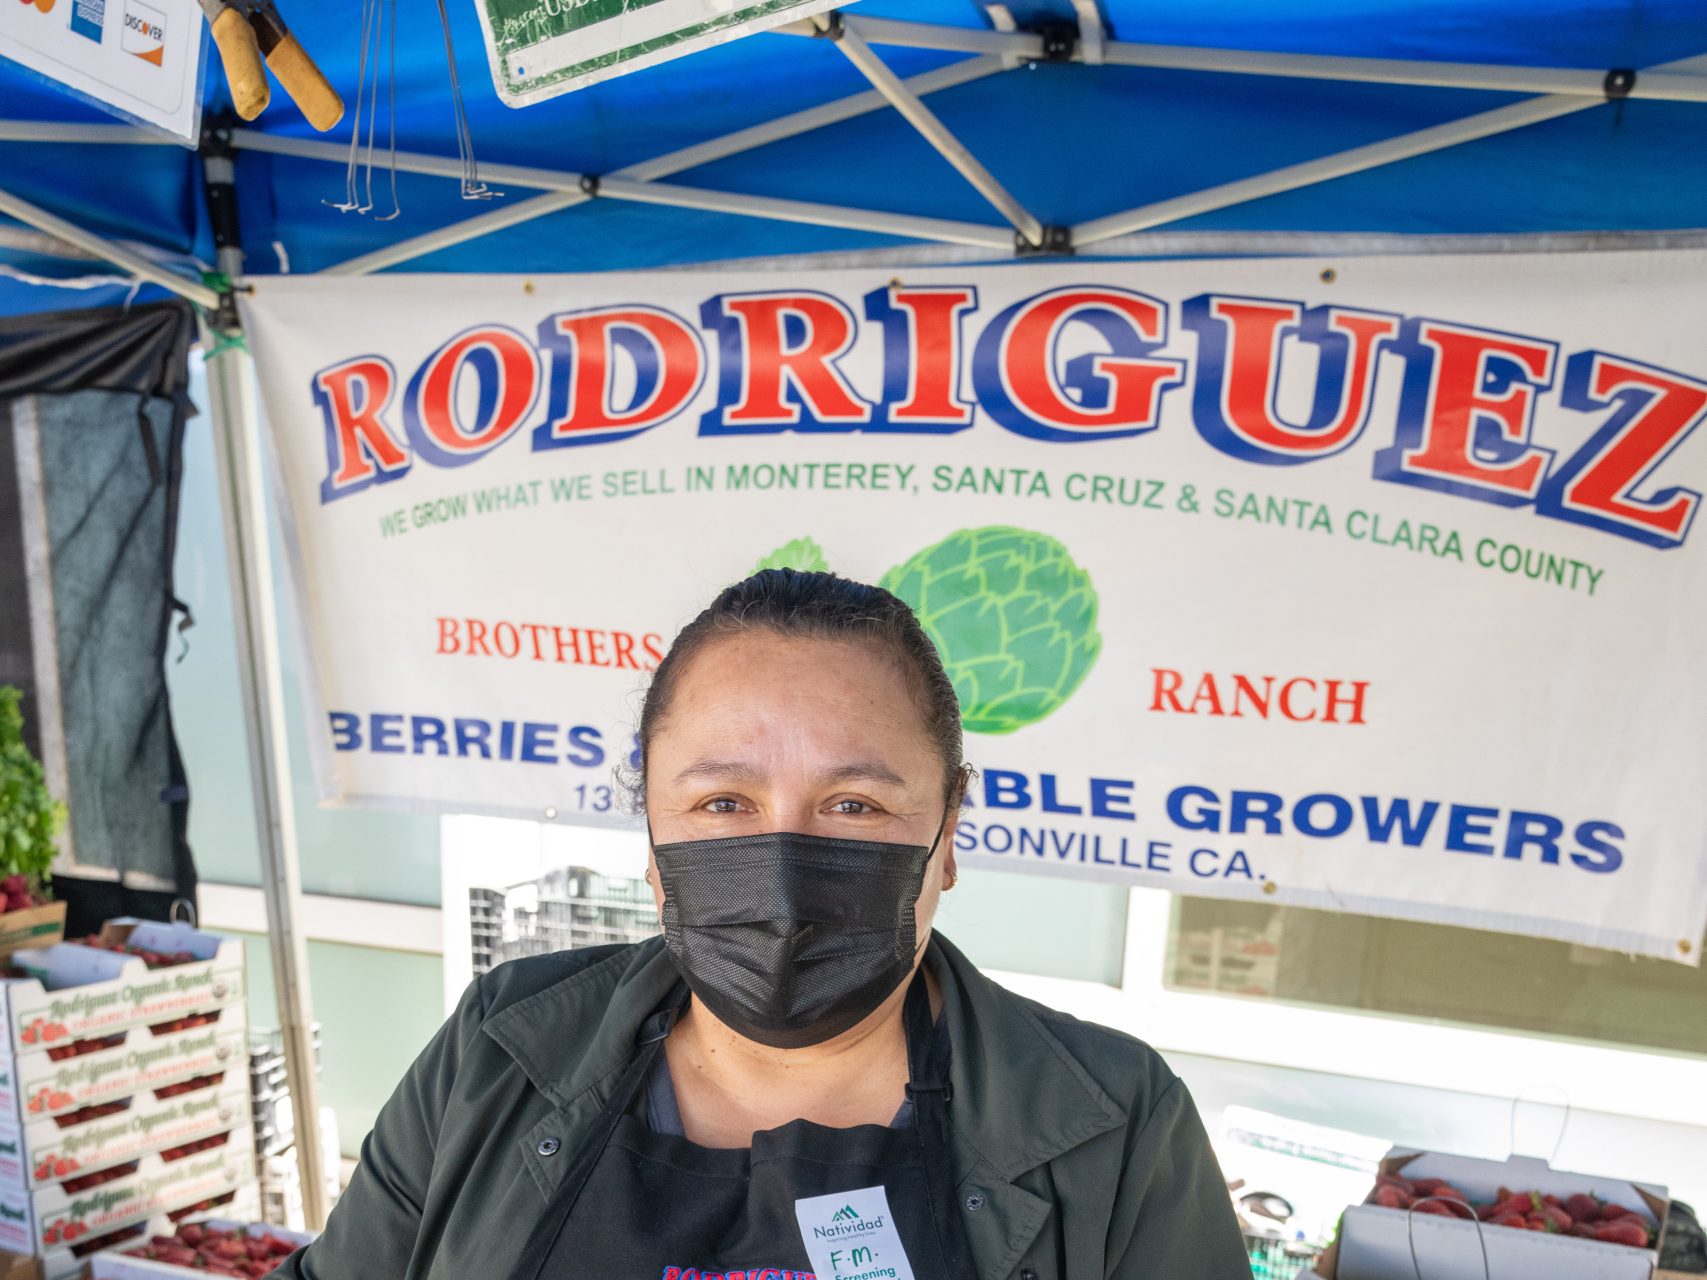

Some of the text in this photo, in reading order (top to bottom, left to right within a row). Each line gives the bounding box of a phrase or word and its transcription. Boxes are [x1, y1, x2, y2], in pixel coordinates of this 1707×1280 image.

[125, 13, 163, 41] DISCOVER
[311, 284, 1707, 550] RODRIGUEZ
[379, 463, 1604, 597] WE GROW WHAT WE SELL IN MONTEREY, SANTA CRUZ & SANTA CLARA COUNTY
[435, 616, 664, 673] BROTHERS
[1148, 668, 1370, 725] RANCH
[328, 711, 606, 768] BERRIES
[954, 822, 1267, 881] SONVILLE CA.
[1165, 784, 1626, 876] GROWERS
